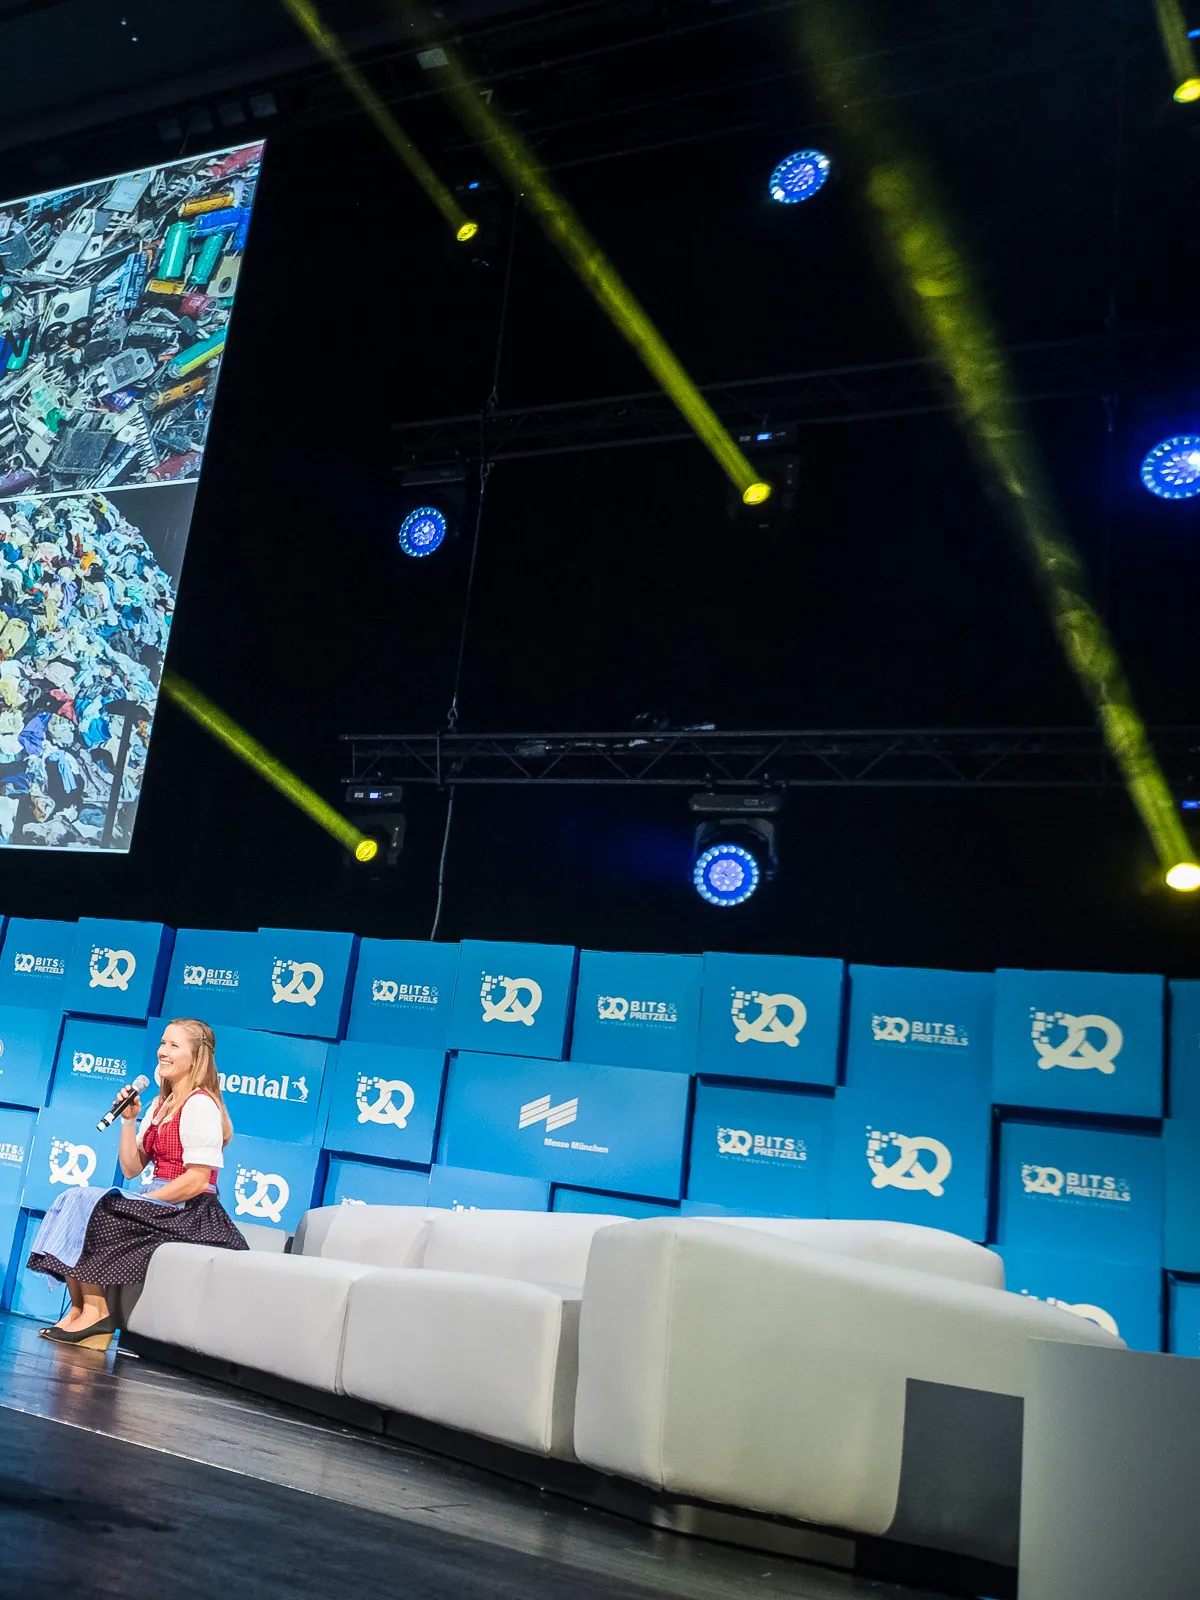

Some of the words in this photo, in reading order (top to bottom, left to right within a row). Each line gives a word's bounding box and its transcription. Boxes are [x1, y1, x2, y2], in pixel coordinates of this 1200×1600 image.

[205, 978, 239, 987] PRETZELS
[398, 994, 438, 1004] PRETZELS
[629, 1012, 677, 1022] PRETZELS
[910, 1033, 969, 1046] PRETZELS
[217, 1072, 289, 1101] nental
[753, 1146, 807, 1161] PRETZELS
[1065, 1185, 1131, 1202] PRETZELS
